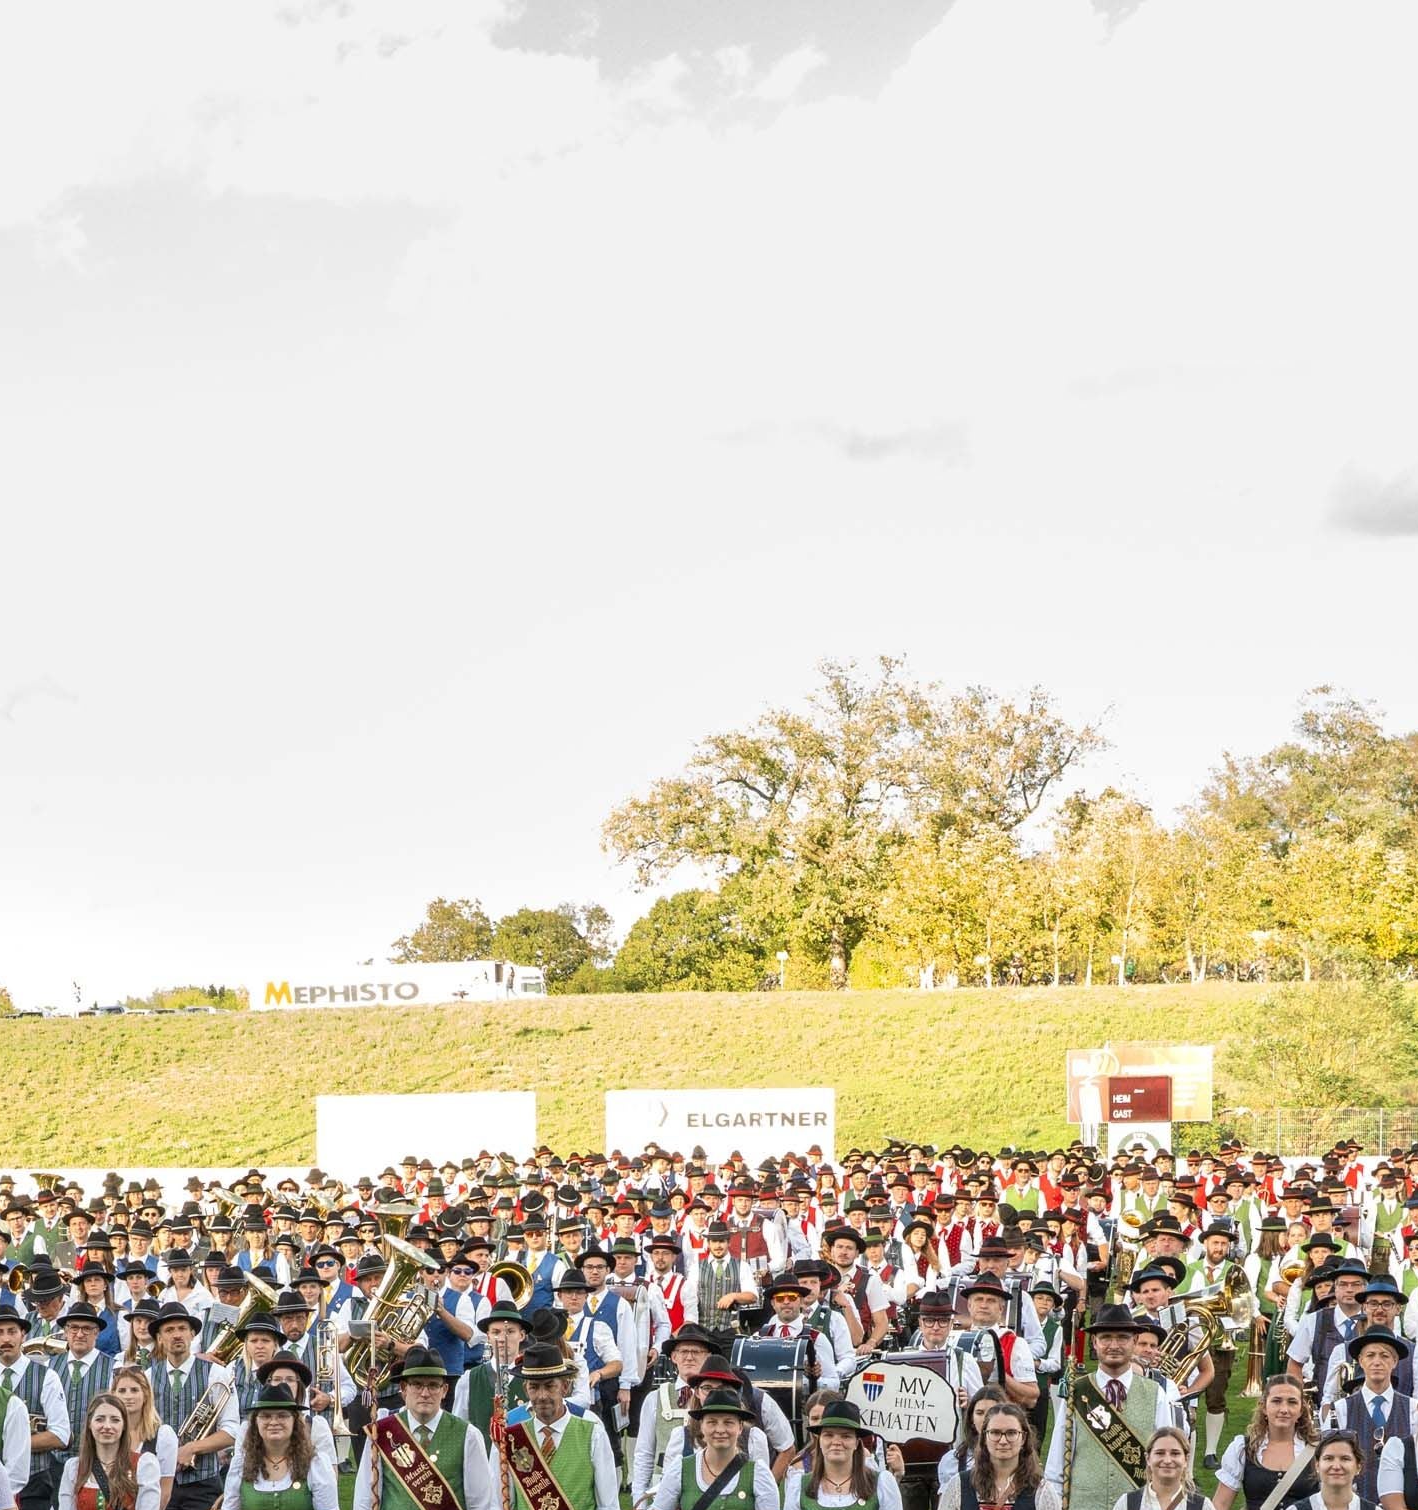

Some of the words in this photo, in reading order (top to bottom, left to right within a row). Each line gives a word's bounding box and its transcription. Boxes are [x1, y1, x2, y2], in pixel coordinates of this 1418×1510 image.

[265, 981, 419, 1005] MEPHISTO
[1113, 1094, 1131, 1103] HEIM
[687, 1111, 827, 1128] ELGARTNER
[1113, 1109, 1132, 1118] GAST
[899, 1375, 932, 1397] MV
[895, 1397, 935, 1410] HILM-
[859, 1408, 939, 1433] KEMATEN
[411, 1469, 434, 1488] verein
